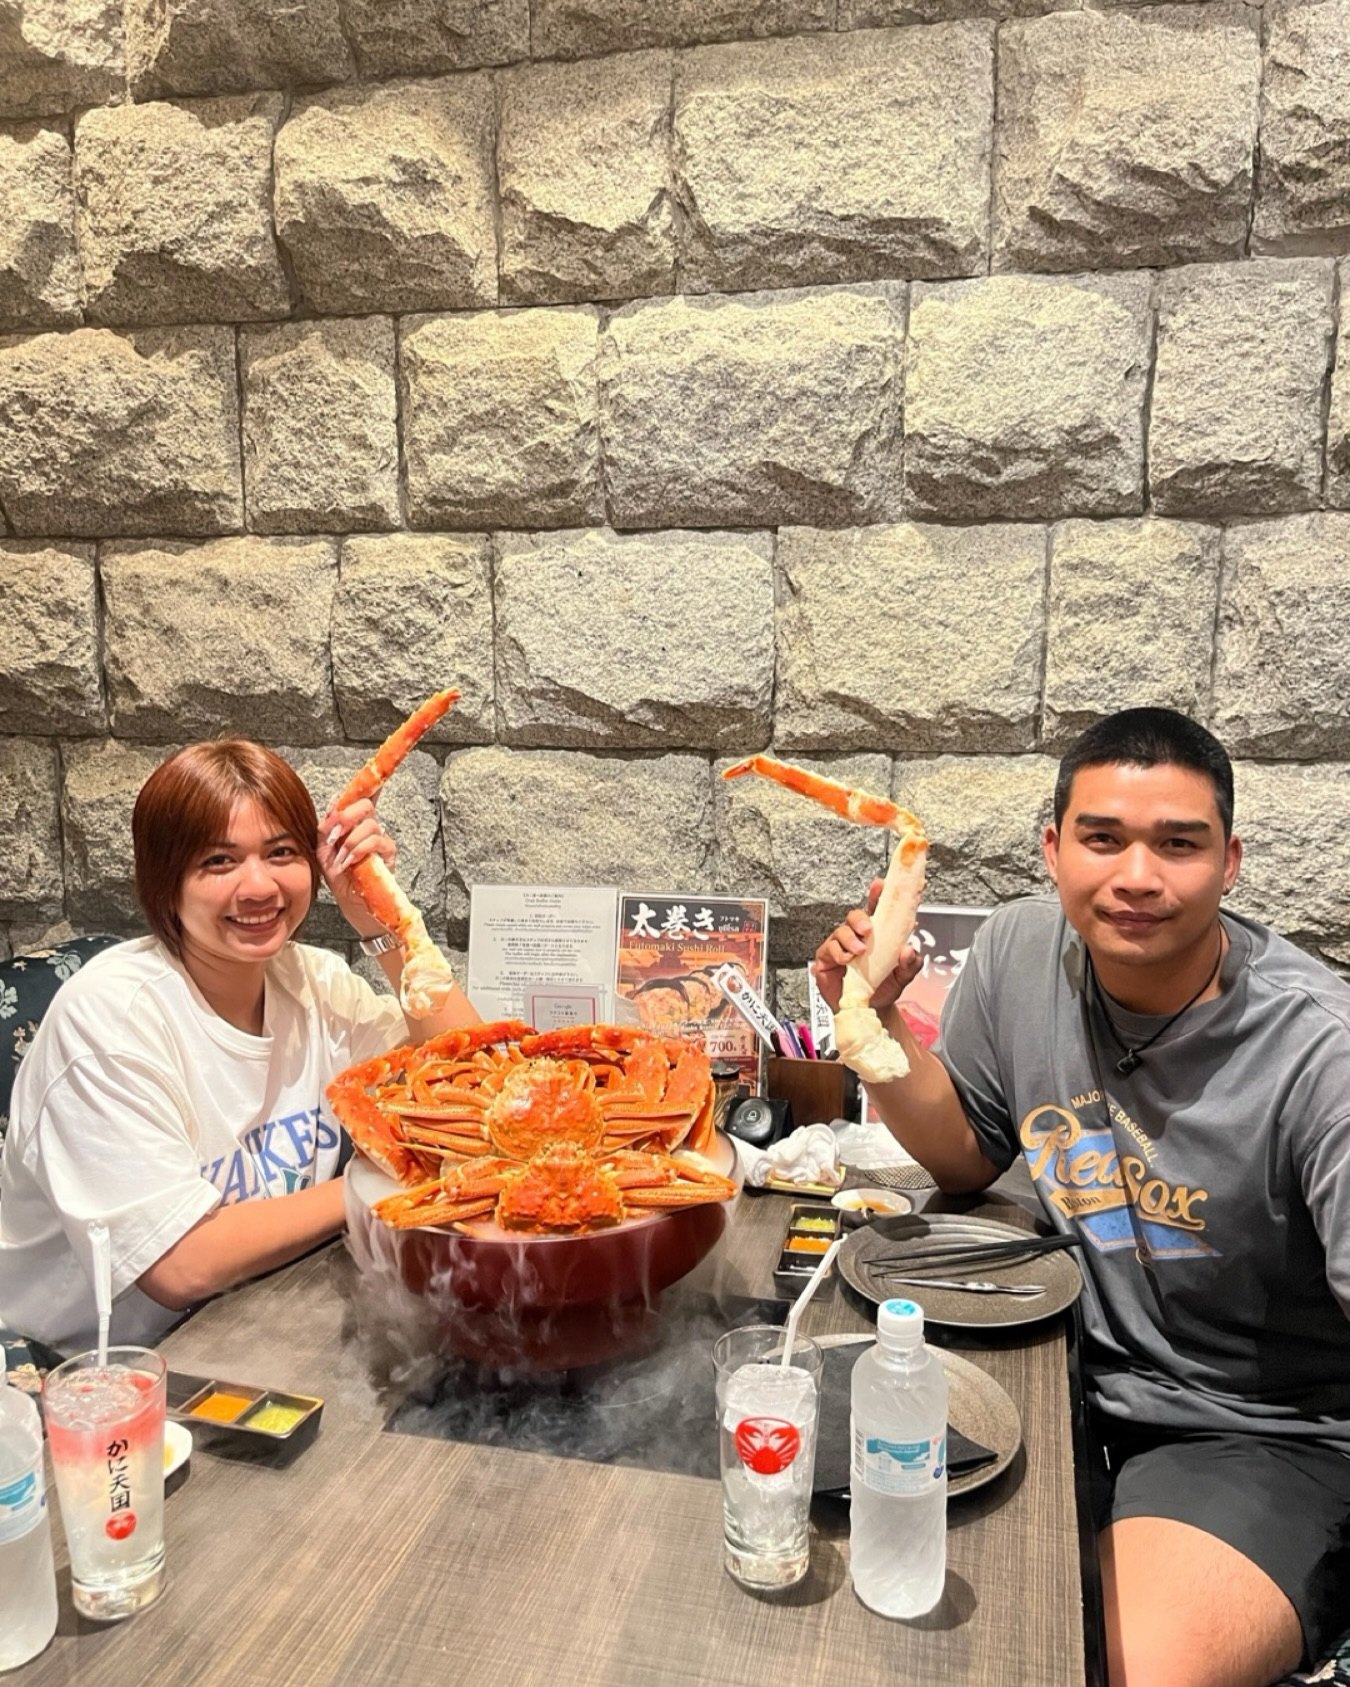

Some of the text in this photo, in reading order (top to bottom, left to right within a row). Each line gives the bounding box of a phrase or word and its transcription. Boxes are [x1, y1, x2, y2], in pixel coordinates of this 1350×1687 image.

[628, 902, 714, 940] 太巻き
[629, 941, 725, 953] Futomaki Sushi Roll
[1071, 1090, 1159, 1163] MAJO BASEBALL
[107, 1439, 131, 1513] かに天国
